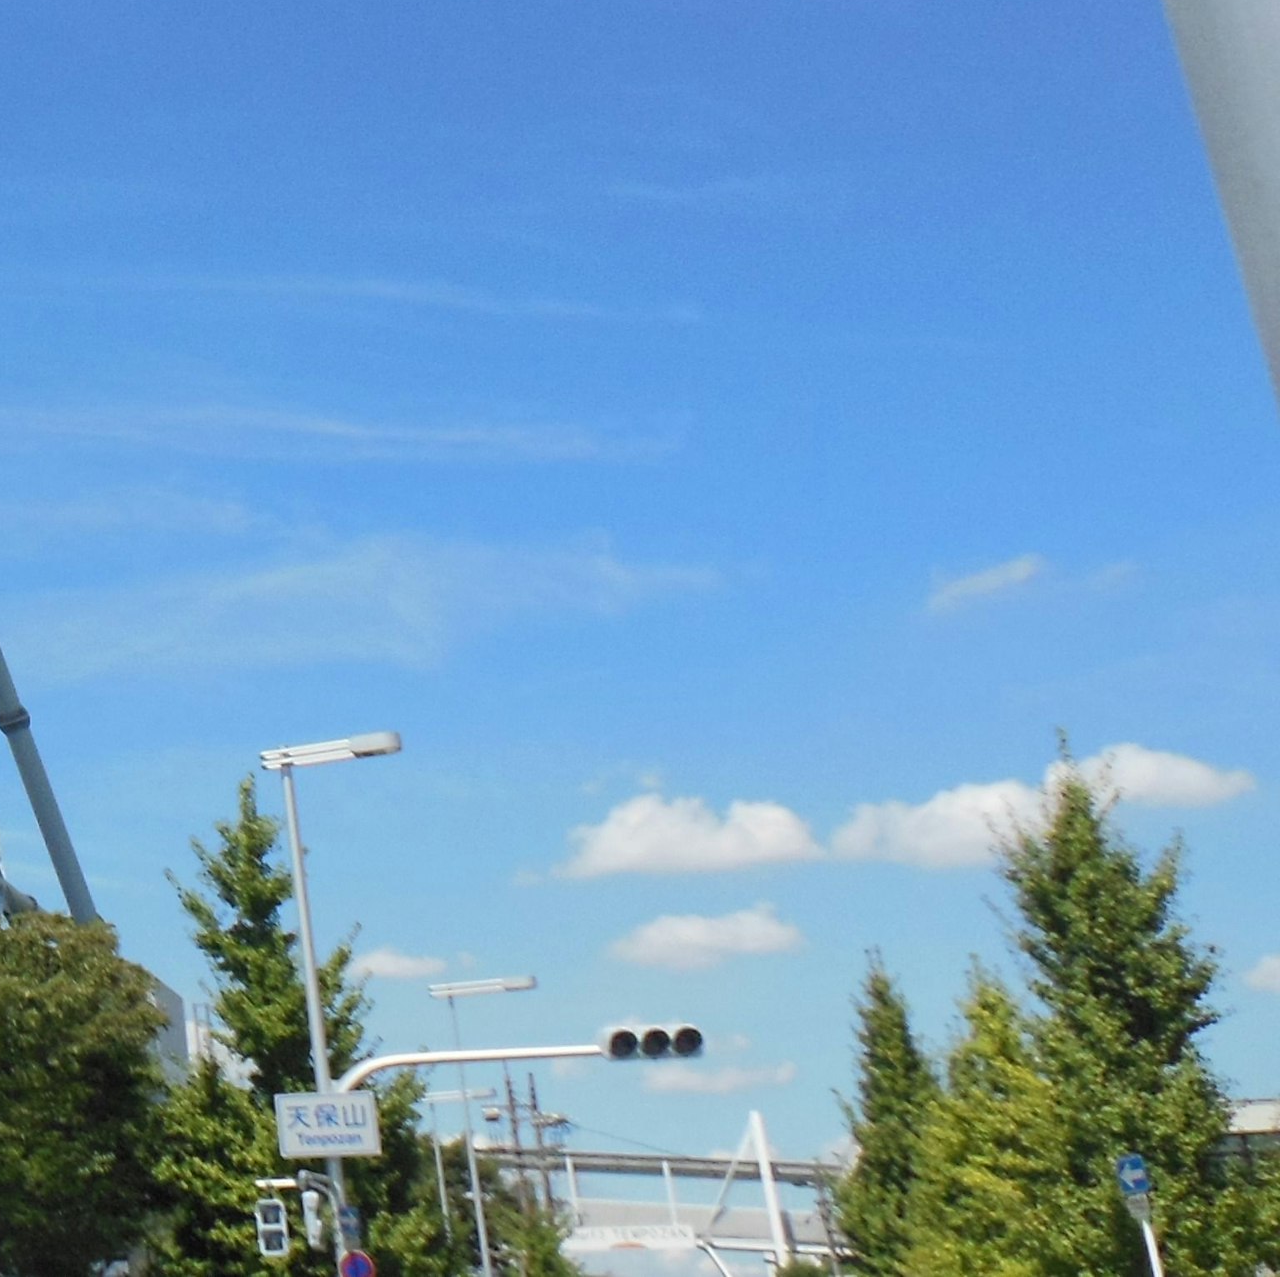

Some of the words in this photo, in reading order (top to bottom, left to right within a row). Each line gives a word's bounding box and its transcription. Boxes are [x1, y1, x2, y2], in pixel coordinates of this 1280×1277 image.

[286, 1104, 366, 1128] 天保山
[297, 1133, 362, 1147] Tenpozan
